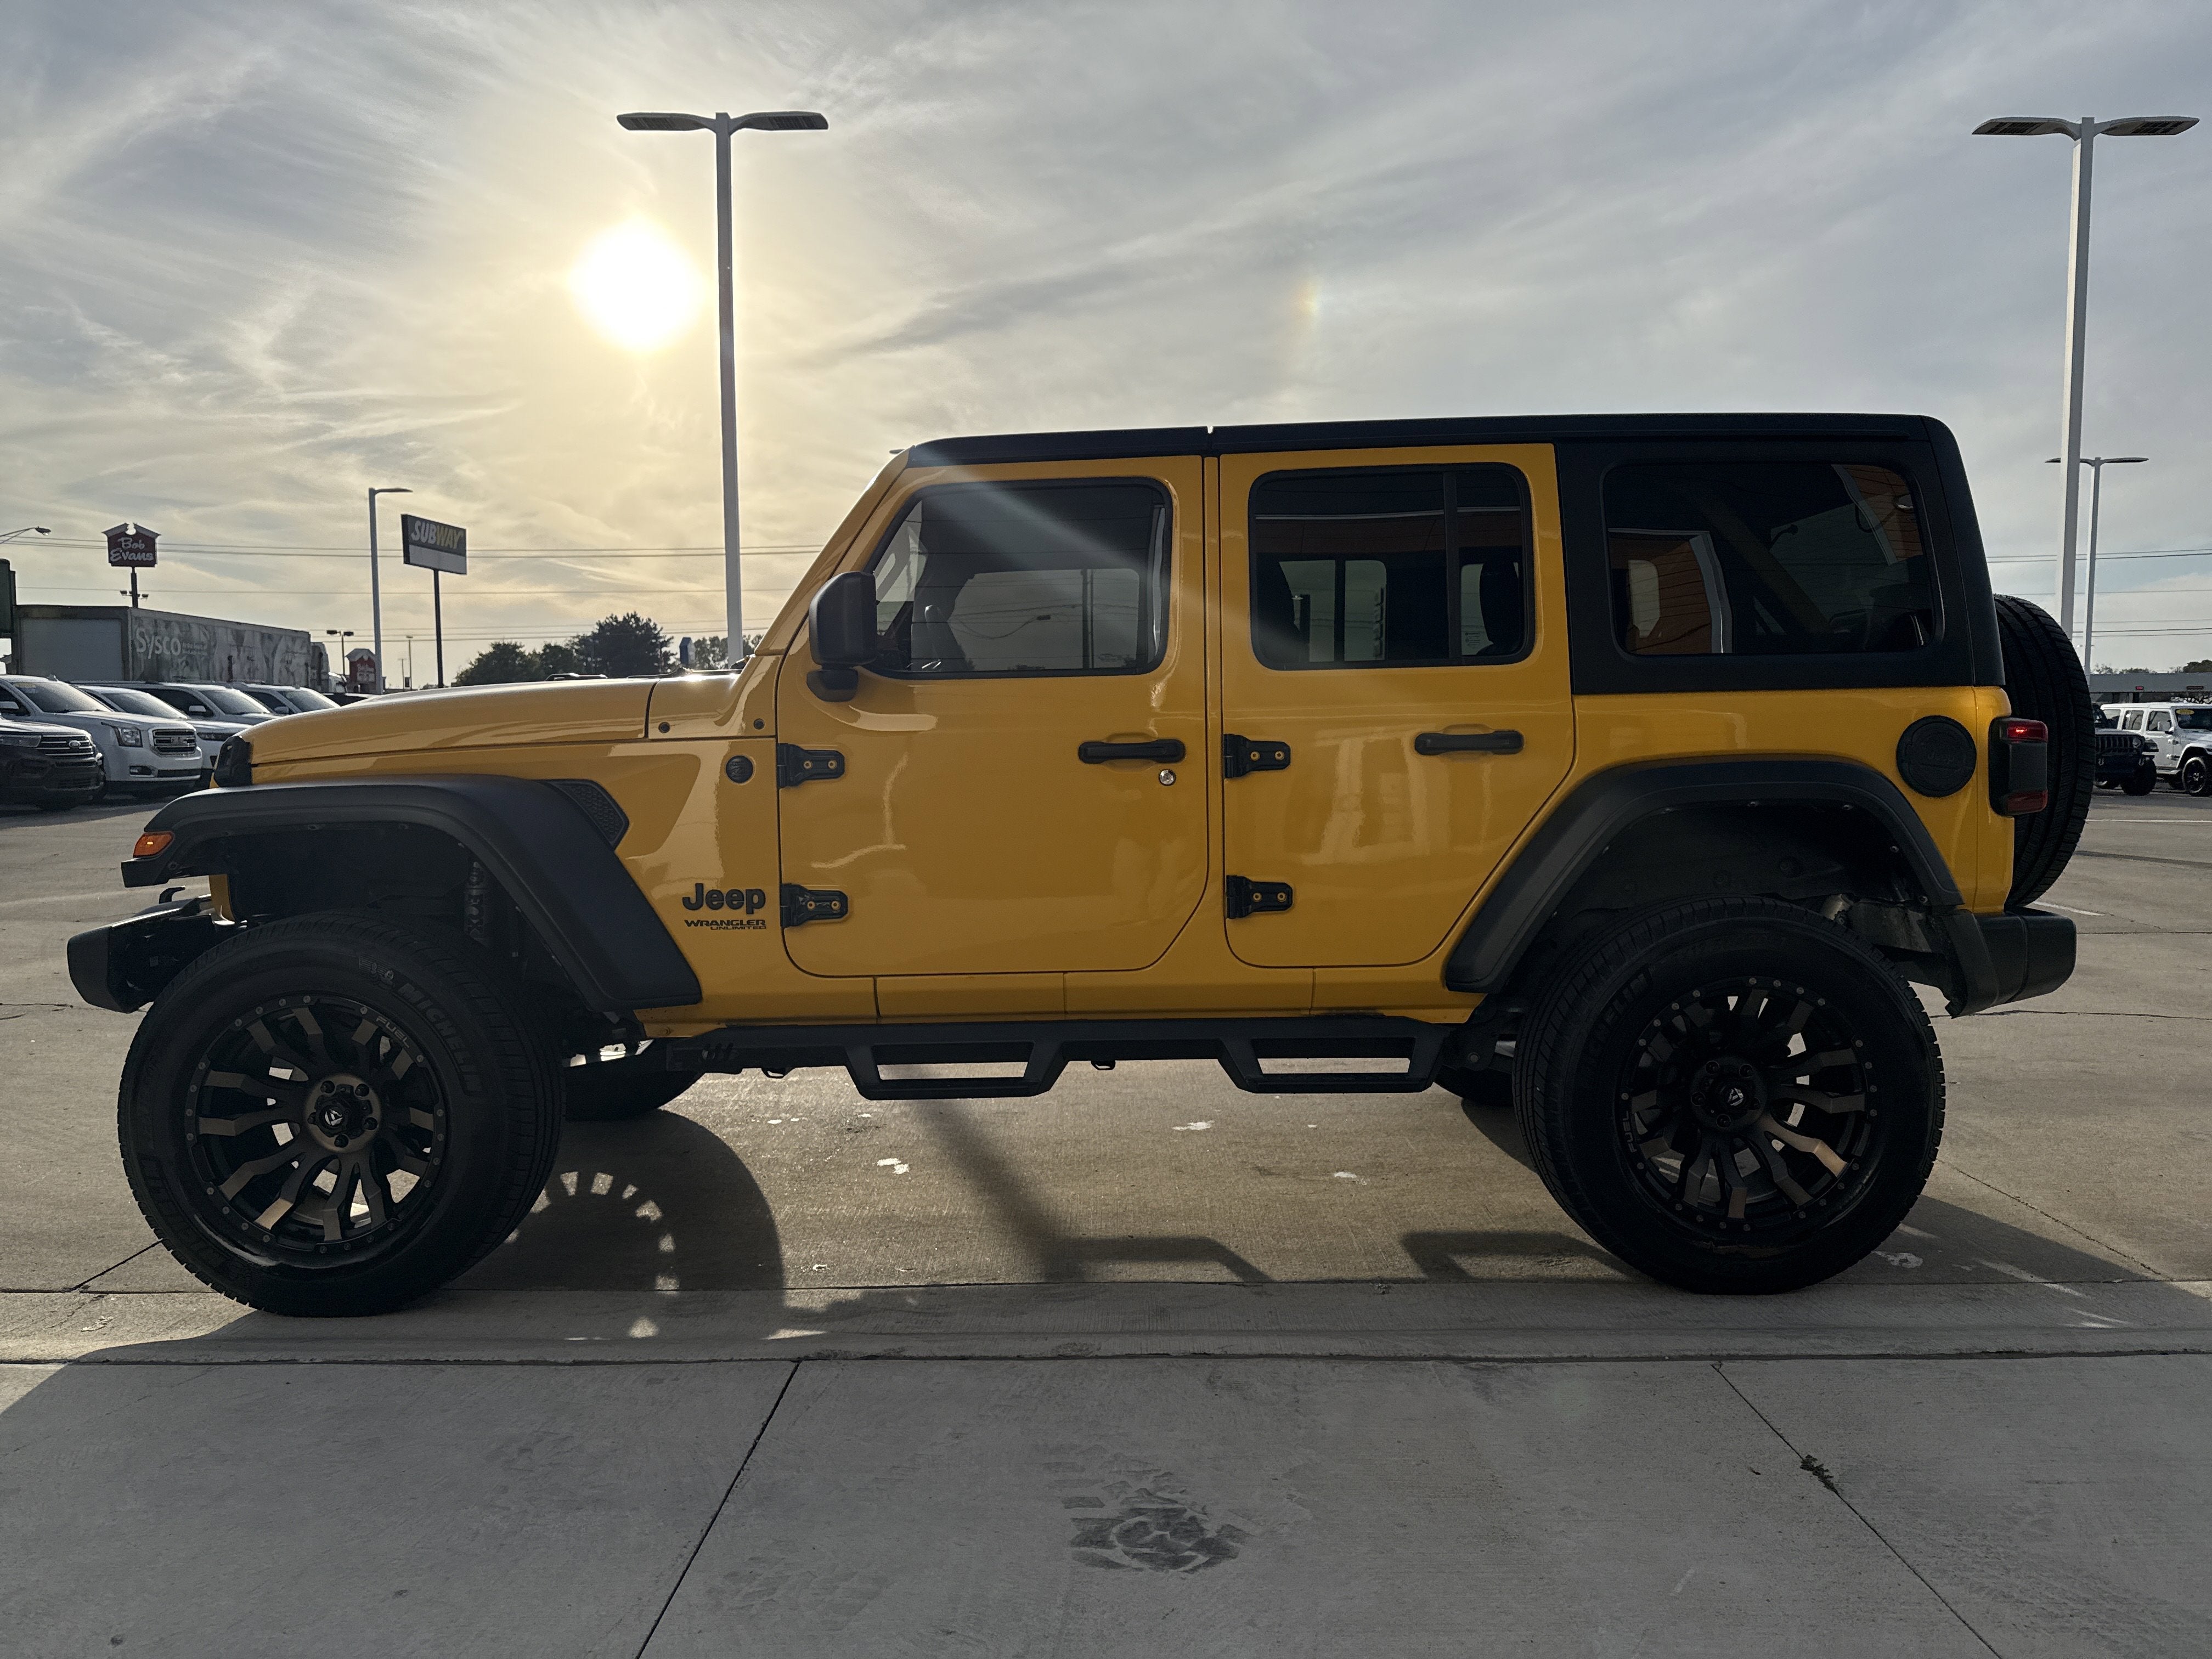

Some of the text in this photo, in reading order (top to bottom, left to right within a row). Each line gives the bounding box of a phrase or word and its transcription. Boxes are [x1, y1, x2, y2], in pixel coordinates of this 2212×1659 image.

[117, 537, 145, 550] Bob
[410, 520, 464, 549] SUBWAY
[110, 547, 154, 562] Evans
[136, 627, 182, 659] Sysco
[682, 883, 766, 915] Jeep
[684, 919, 766, 927] WRANGLER
[376, 1015, 410, 1048] FUEL
[1622, 1110, 1638, 1153] FUEL
